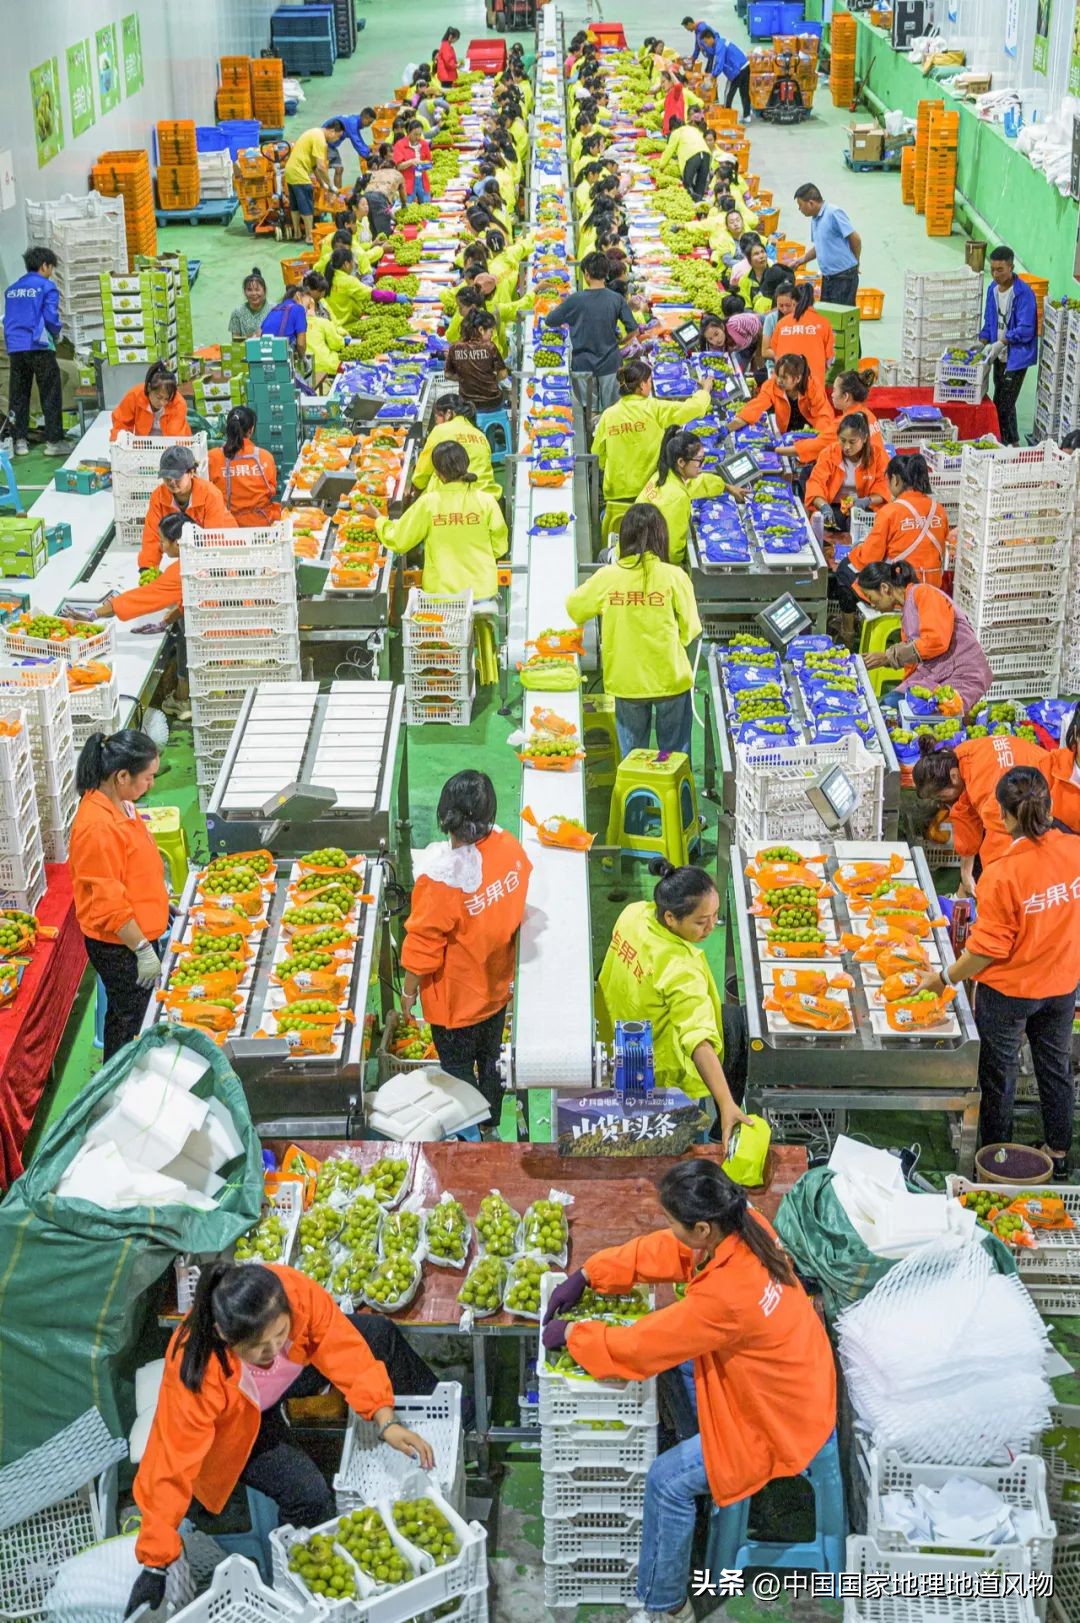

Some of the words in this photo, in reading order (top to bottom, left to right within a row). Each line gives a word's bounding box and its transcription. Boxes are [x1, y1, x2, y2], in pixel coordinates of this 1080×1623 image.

[780, 324, 817, 336] 吉果仓
[454, 350, 468, 360] IRIS
[608, 420, 646, 436] 吉果仓
[432, 512, 480, 526] 吉果仓
[608, 590, 665, 607] 吉果仓
[463, 870, 520, 916] 吉果仓
[572, 1113, 678, 1142] 山货上头条
[758, 1279, 783, 1317] 吉
